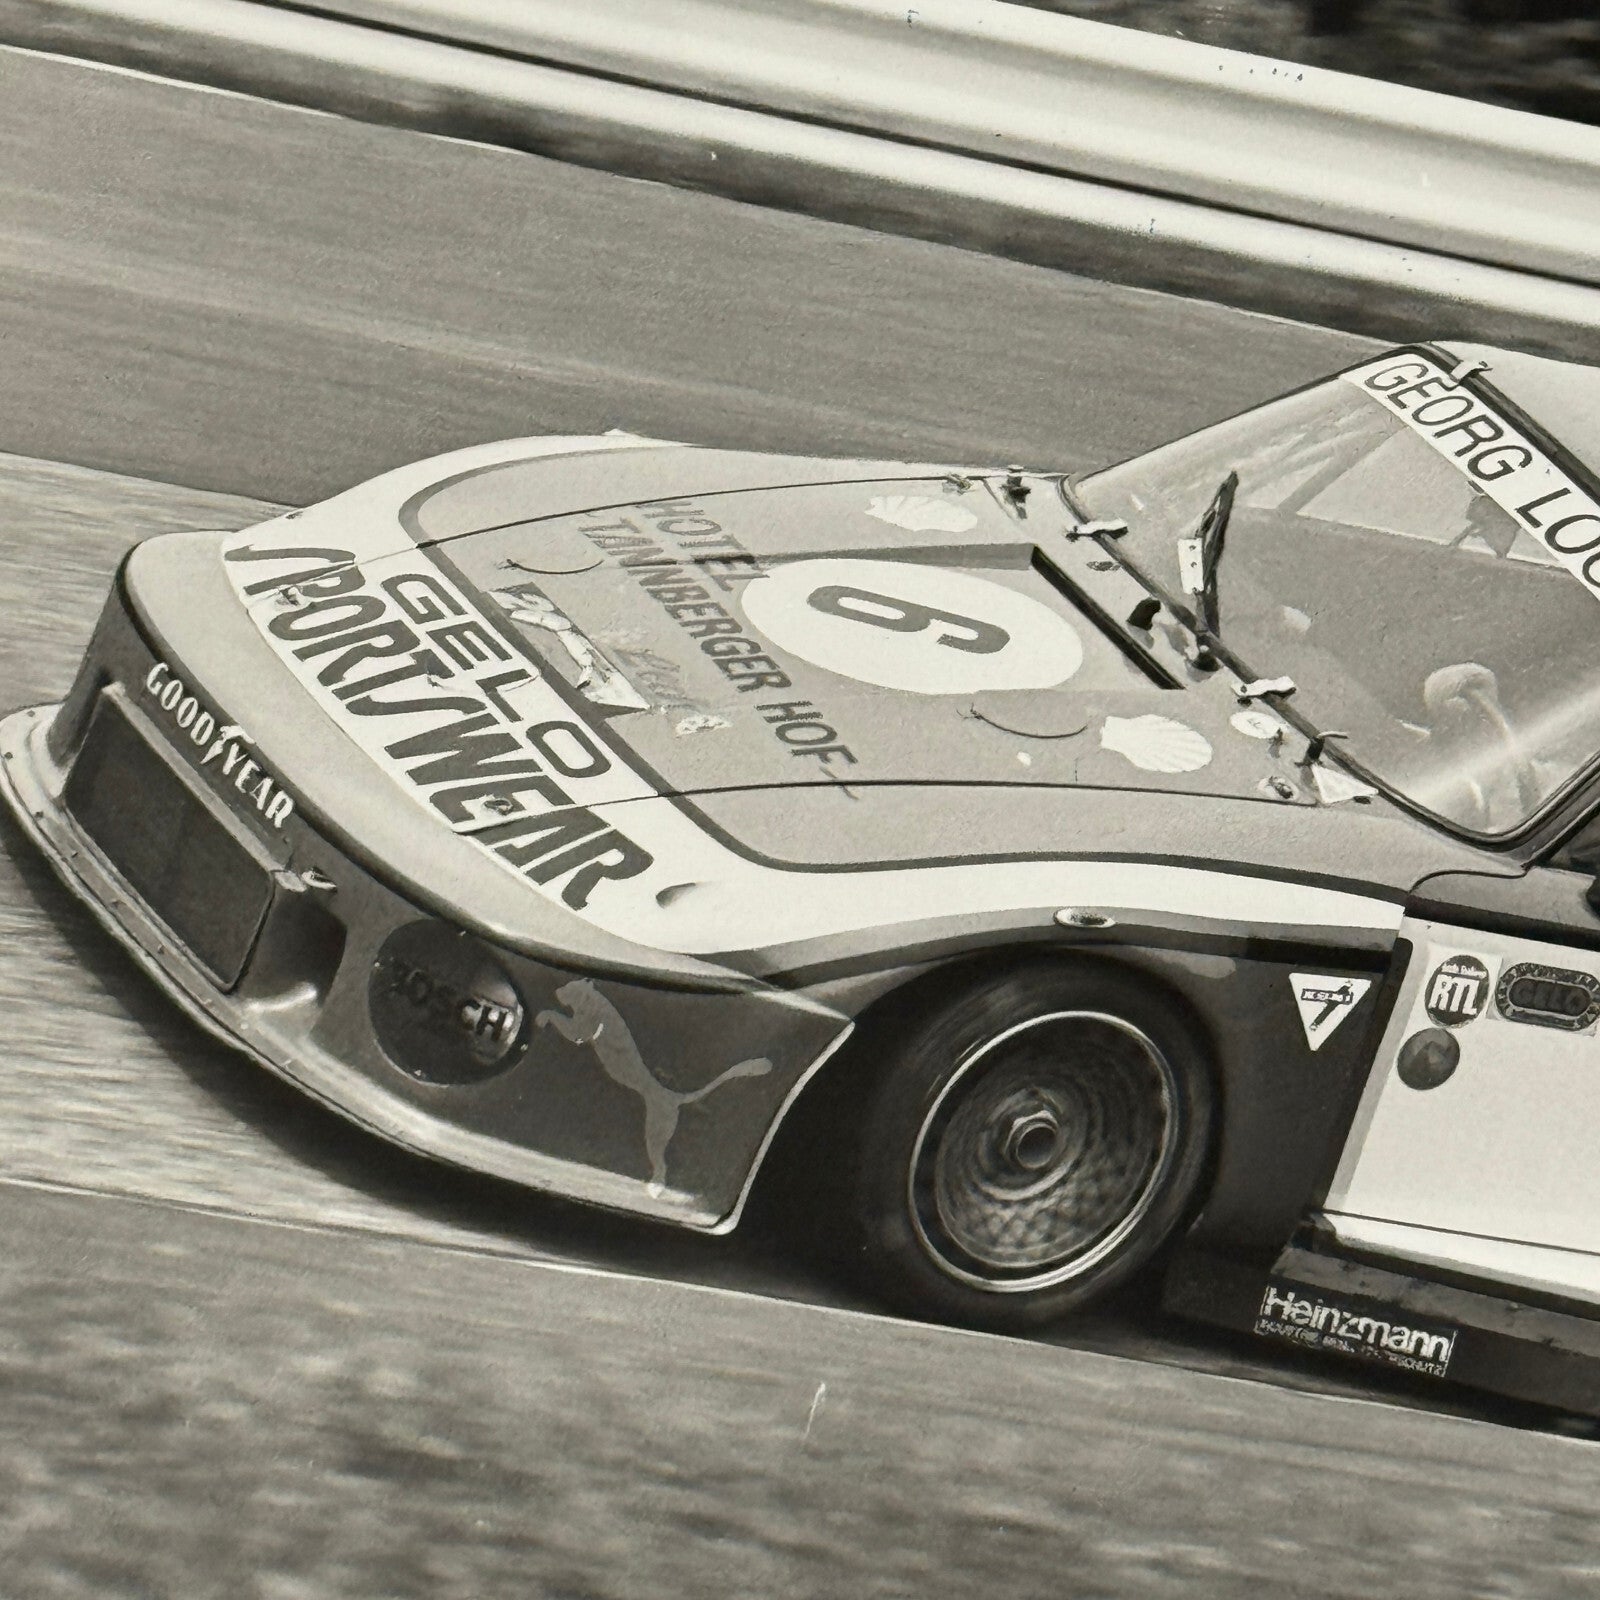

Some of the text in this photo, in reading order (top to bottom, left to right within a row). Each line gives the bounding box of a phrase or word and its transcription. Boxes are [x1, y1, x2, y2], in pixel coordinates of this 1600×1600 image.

[1363, 362, 1533, 482] GEORG
[634, 502, 771, 592] HOTEL
[806, 584, 1011, 654] 6
[380, 573, 612, 779] GELO
[146, 662, 295, 829] GOODYEAR
[224, 543, 655, 911] SPORTSWEAR
[754, 700, 859, 765] HOF
[1429, 972, 1481, 1016] RTL
[1263, 1287, 1450, 1363] Heinzmann
